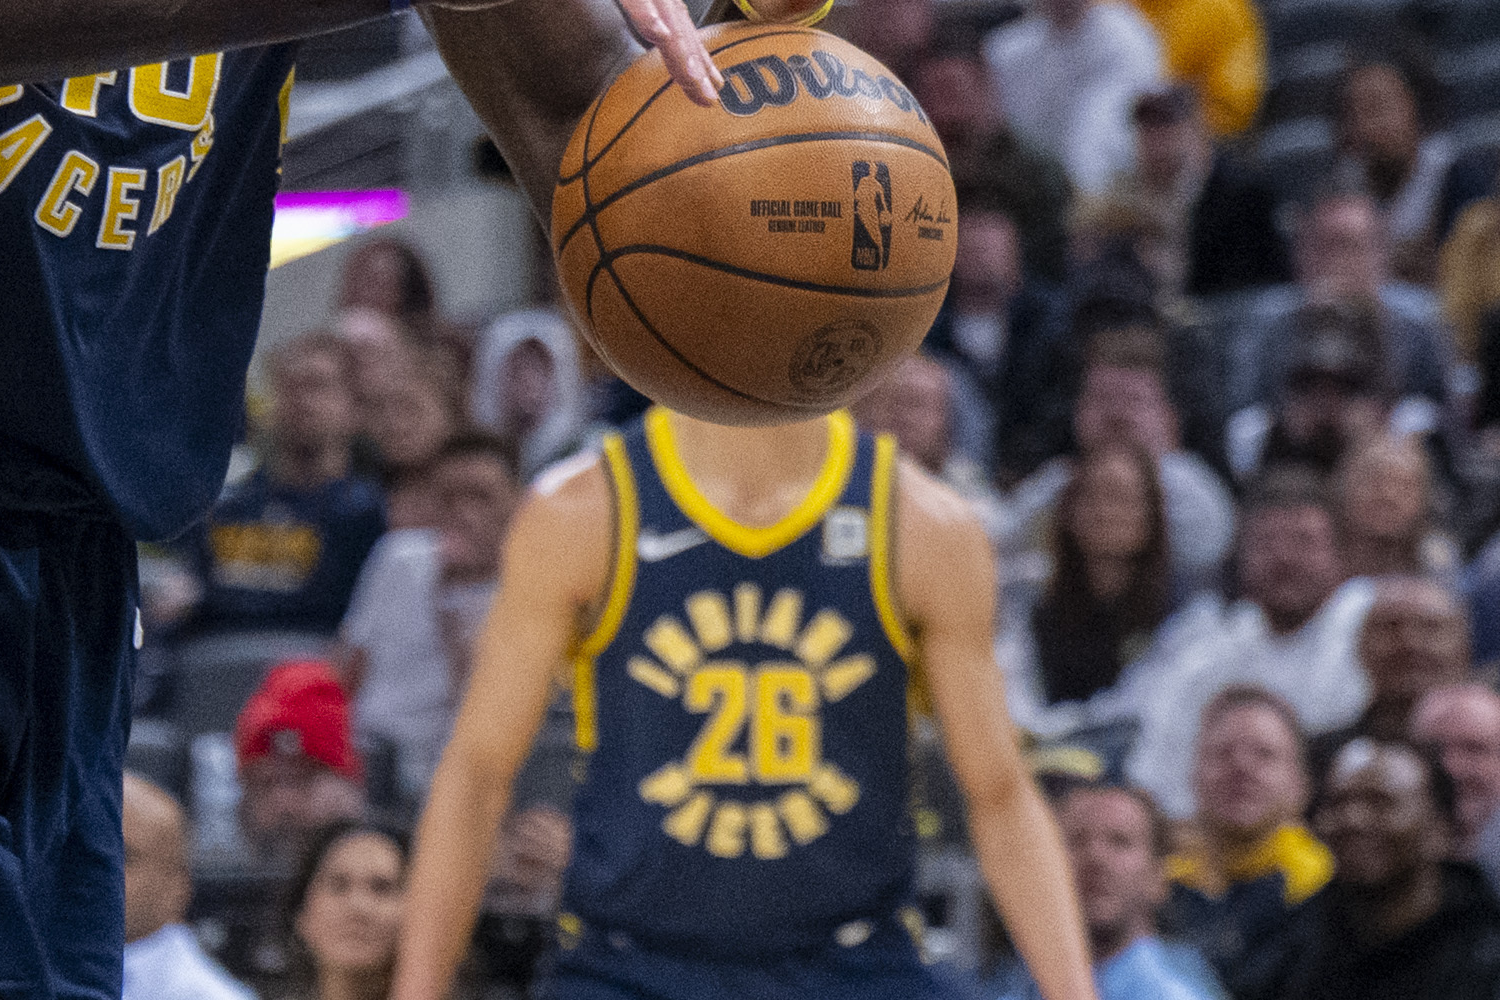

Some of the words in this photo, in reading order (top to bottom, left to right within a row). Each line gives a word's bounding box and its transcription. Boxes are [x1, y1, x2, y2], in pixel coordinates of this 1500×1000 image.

[750, 200, 790, 217] OFFICIAL
[794, 200, 818, 218] GAME
[821, 201, 843, 219] BALL
[684, 661, 823, 785] 26
